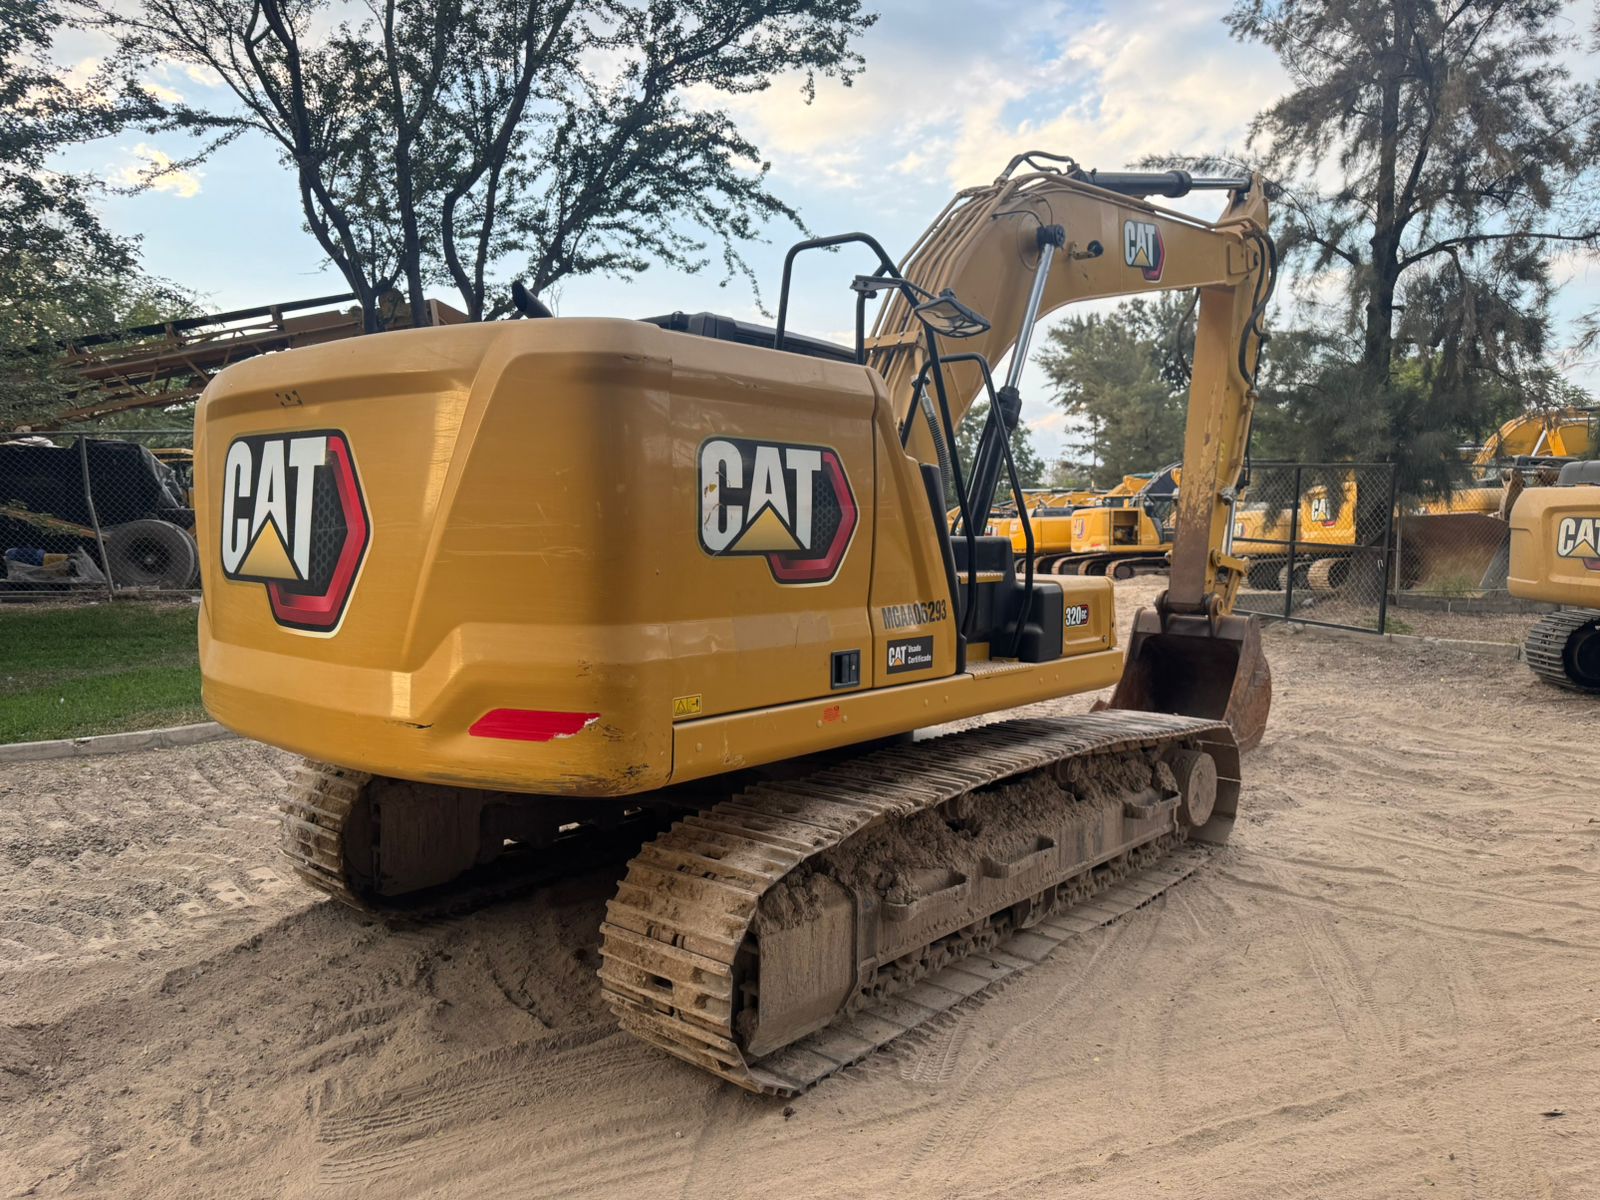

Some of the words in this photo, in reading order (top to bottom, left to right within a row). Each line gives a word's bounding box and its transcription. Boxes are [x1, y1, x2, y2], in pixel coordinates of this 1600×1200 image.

[1124, 220, 1156, 267] CAT
[222, 436, 327, 581] CAT
[701, 440, 821, 551] CAT
[1557, 517, 1600, 557] CA
[881, 599, 947, 630] MGAA06293
[888, 645, 907, 667] CAT
